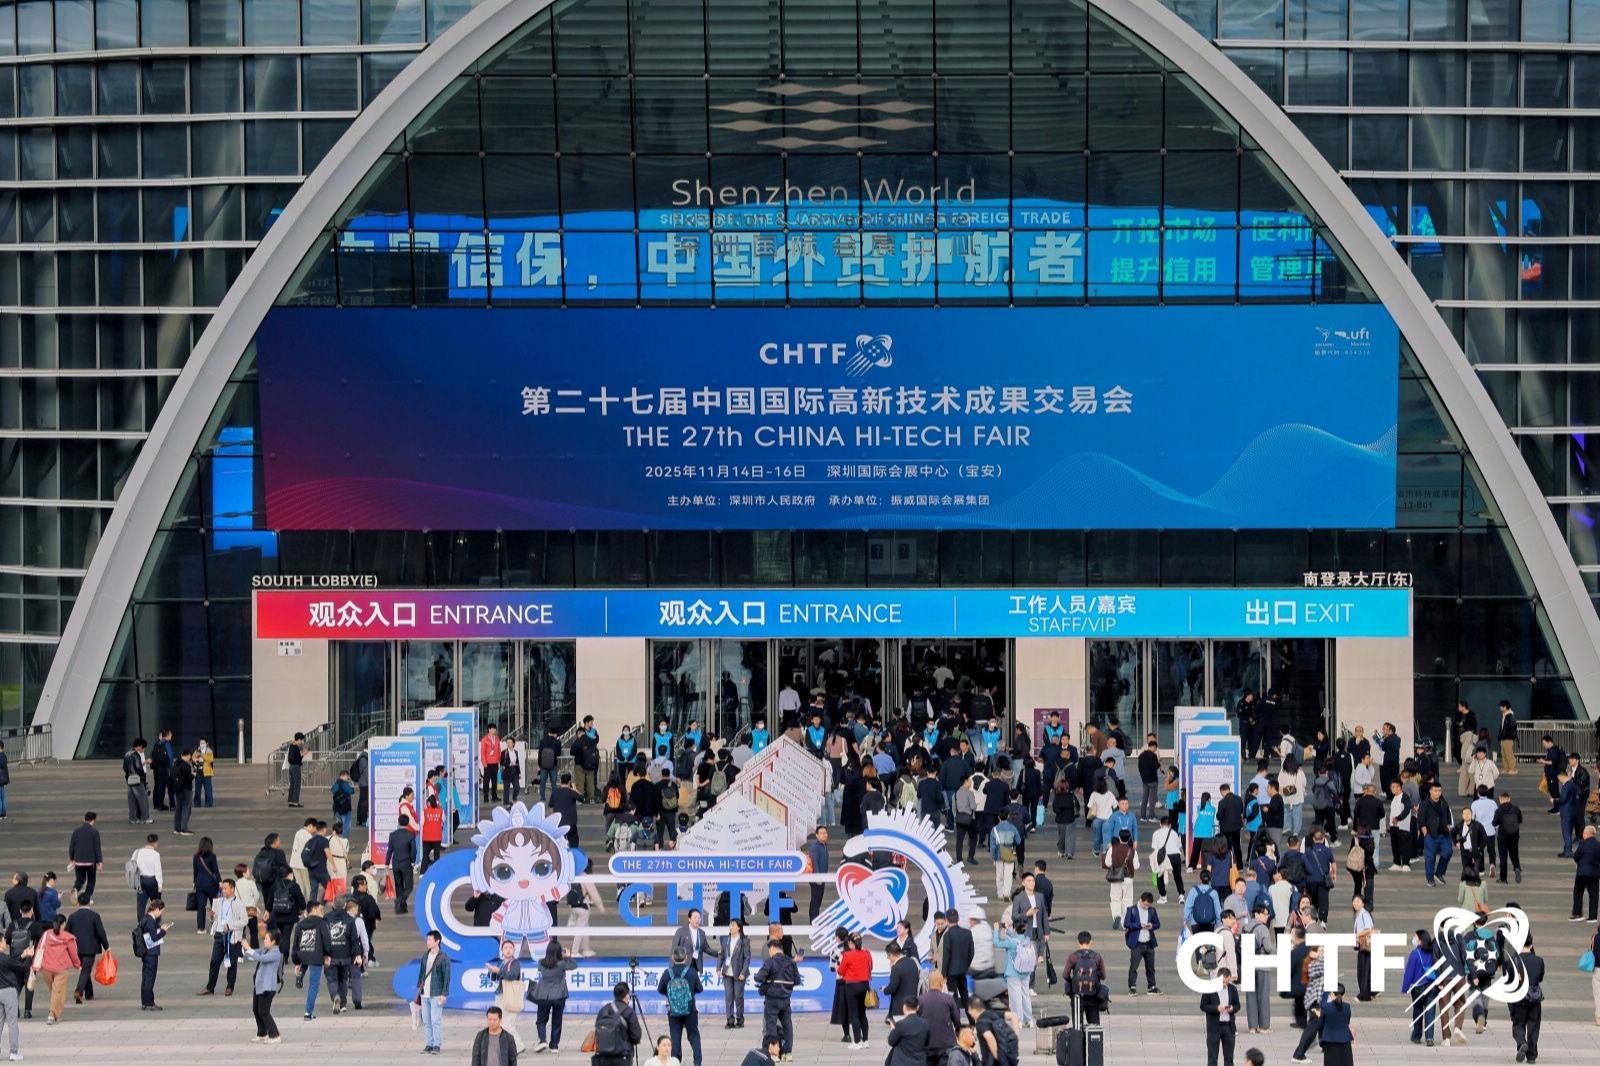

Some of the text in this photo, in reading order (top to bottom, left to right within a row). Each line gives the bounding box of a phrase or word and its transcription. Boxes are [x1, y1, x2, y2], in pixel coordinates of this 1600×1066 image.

[672, 177, 975, 206] Shenzhen World
[951, 212, 1010, 224] FOREIG
[1020, 212, 1071, 225] TRADE
[1111, 257, 1217, 283] 提升信用
[759, 342, 847, 365] CHTF
[520, 385, 1134, 417] 第二十七届中国国际高新技术成果交易会
[622, 426, 1031, 447] THE 27th CHINA HI-TECH FAIR
[645, 463, 1003, 479] 2025年11月14日-16日 深圳国际会展中心（宝安）
[667, 494, 816, 507] 主办单位：深圳市人民政府
[251, 575, 379, 588] SOUTH LOBBY(E)
[1303, 571, 1414, 588] 南登录大厅(东)
[309, 601, 554, 628] 观众入口 ENTRANCE
[658, 600, 903, 626] 观众入口 ENTRANCE
[1008, 594, 1137, 615] 工作人员/嘉宾
[1245, 600, 1355, 626] 出口 EXIT
[1028, 616, 1118, 633] STAFF/VIP
[622, 859, 793, 870] THE 27th CHINA HI-TECH FAIR
[618, 882, 796, 927] CHTF
